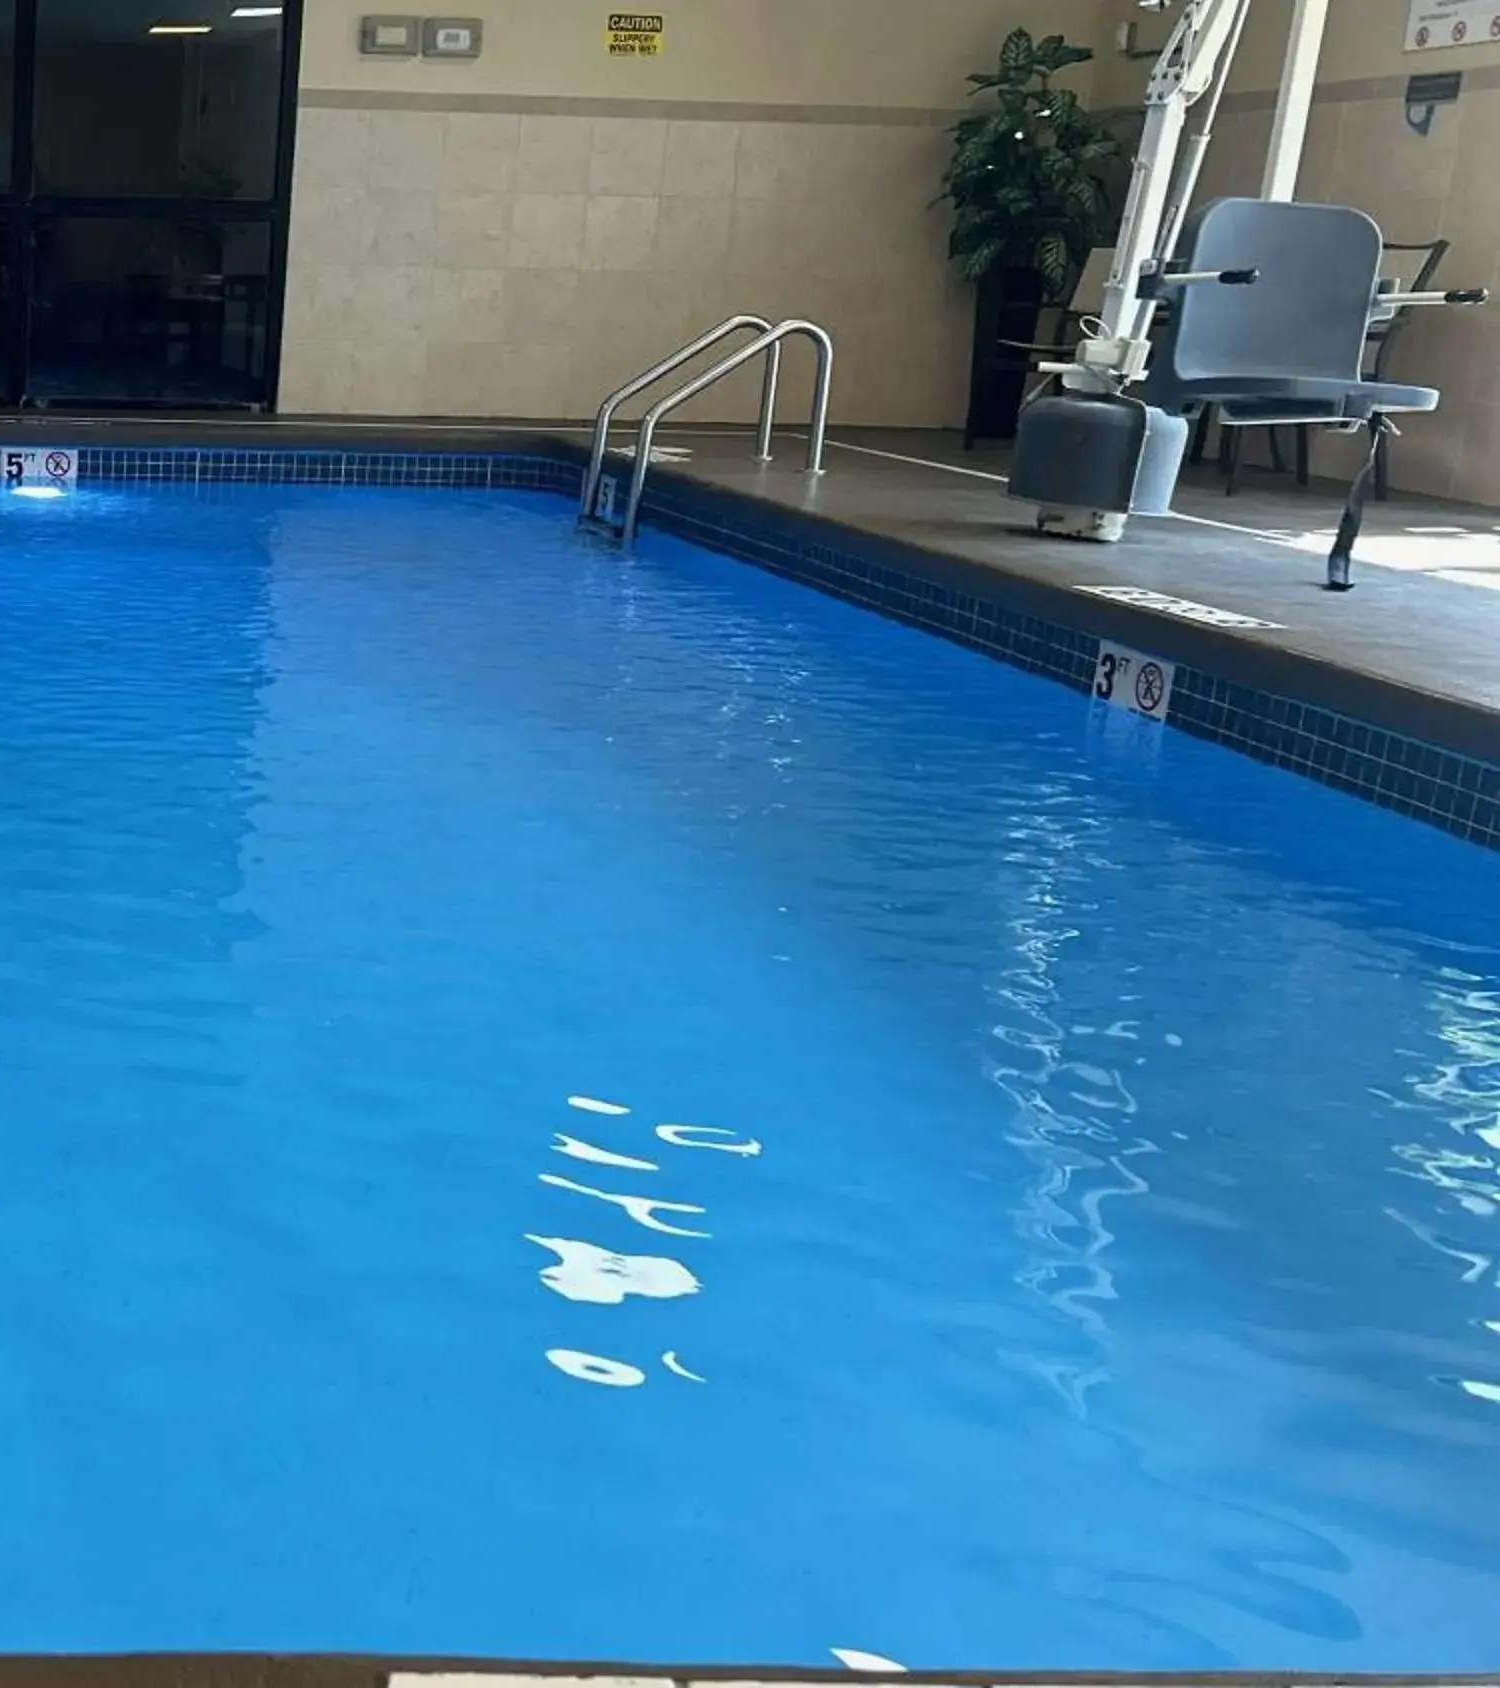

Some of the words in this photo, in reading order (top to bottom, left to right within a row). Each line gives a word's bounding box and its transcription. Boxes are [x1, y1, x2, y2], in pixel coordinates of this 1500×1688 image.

[610, 16, 661, 30] CAUTION
[6, 453, 23, 476] 5
[1096, 653, 1116, 700] 3
